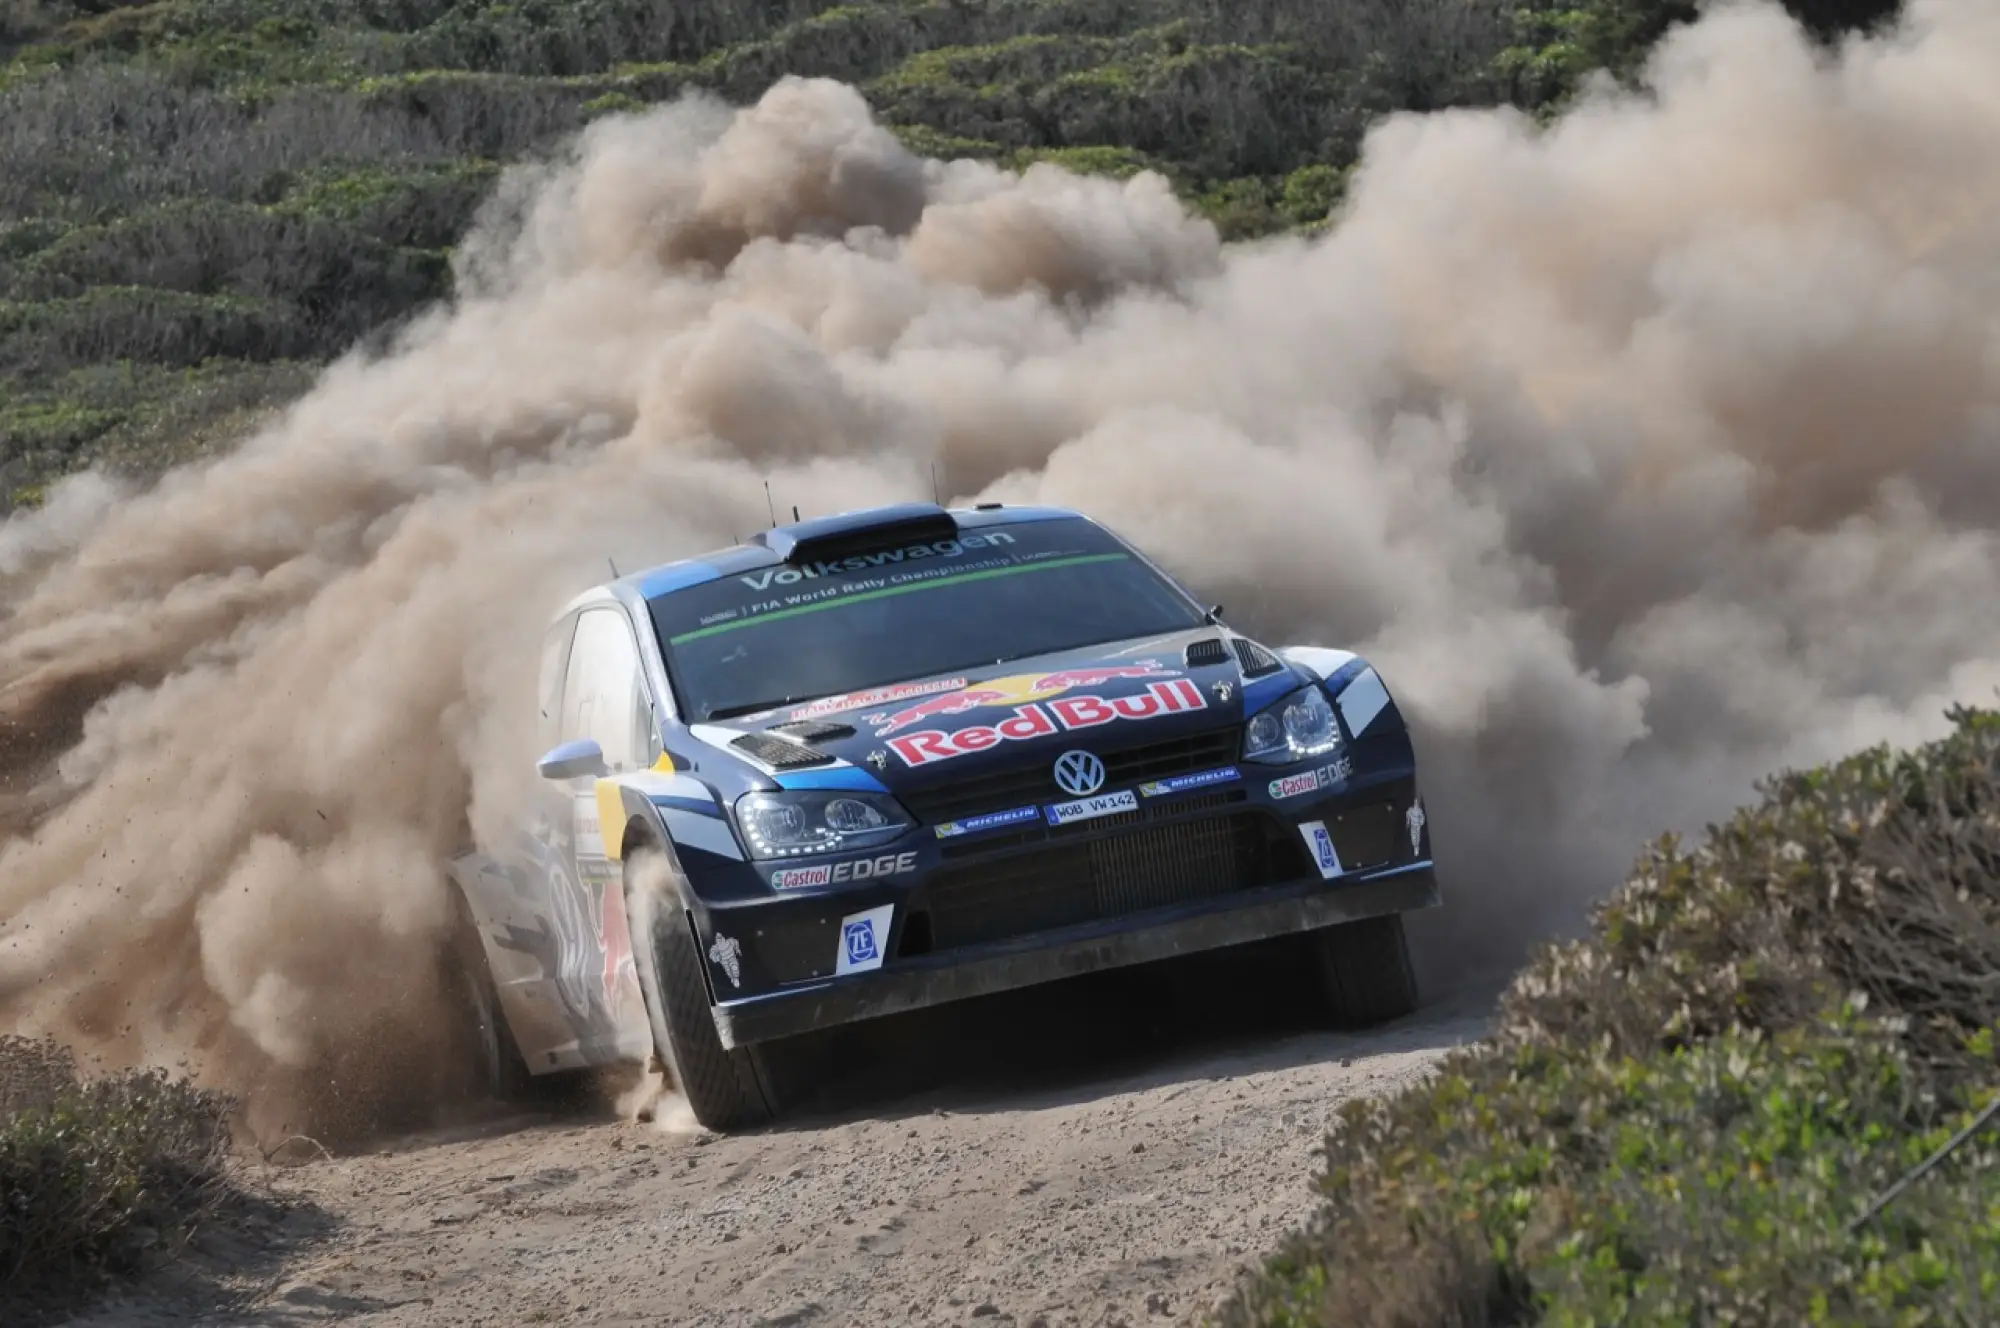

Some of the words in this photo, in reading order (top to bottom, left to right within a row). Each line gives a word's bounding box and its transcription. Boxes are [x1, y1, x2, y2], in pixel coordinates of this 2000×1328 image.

[740, 531, 1015, 591] Volkswagen
[751, 599, 781, 613] FIA
[784, 587, 837, 604] World
[842, 578, 884, 593] Rally
[890, 557, 1010, 583] Championship
[887, 705, 1053, 766] Red
[1052, 679, 1206, 729] Bull
[1171, 769, 1235, 788] MICHELIN
[1283, 771, 1316, 796] Castrol
[1317, 756, 1353, 788] EDGE
[967, 808, 1035, 829] MICHELIN
[1057, 804, 1084, 818] WOB
[1089, 799, 1107, 813] VW
[1111, 794, 1135, 808] 142
[783, 864, 828, 888] Castrol
[832, 851, 918, 884] EDGE
[848, 928, 874, 955] ZF
